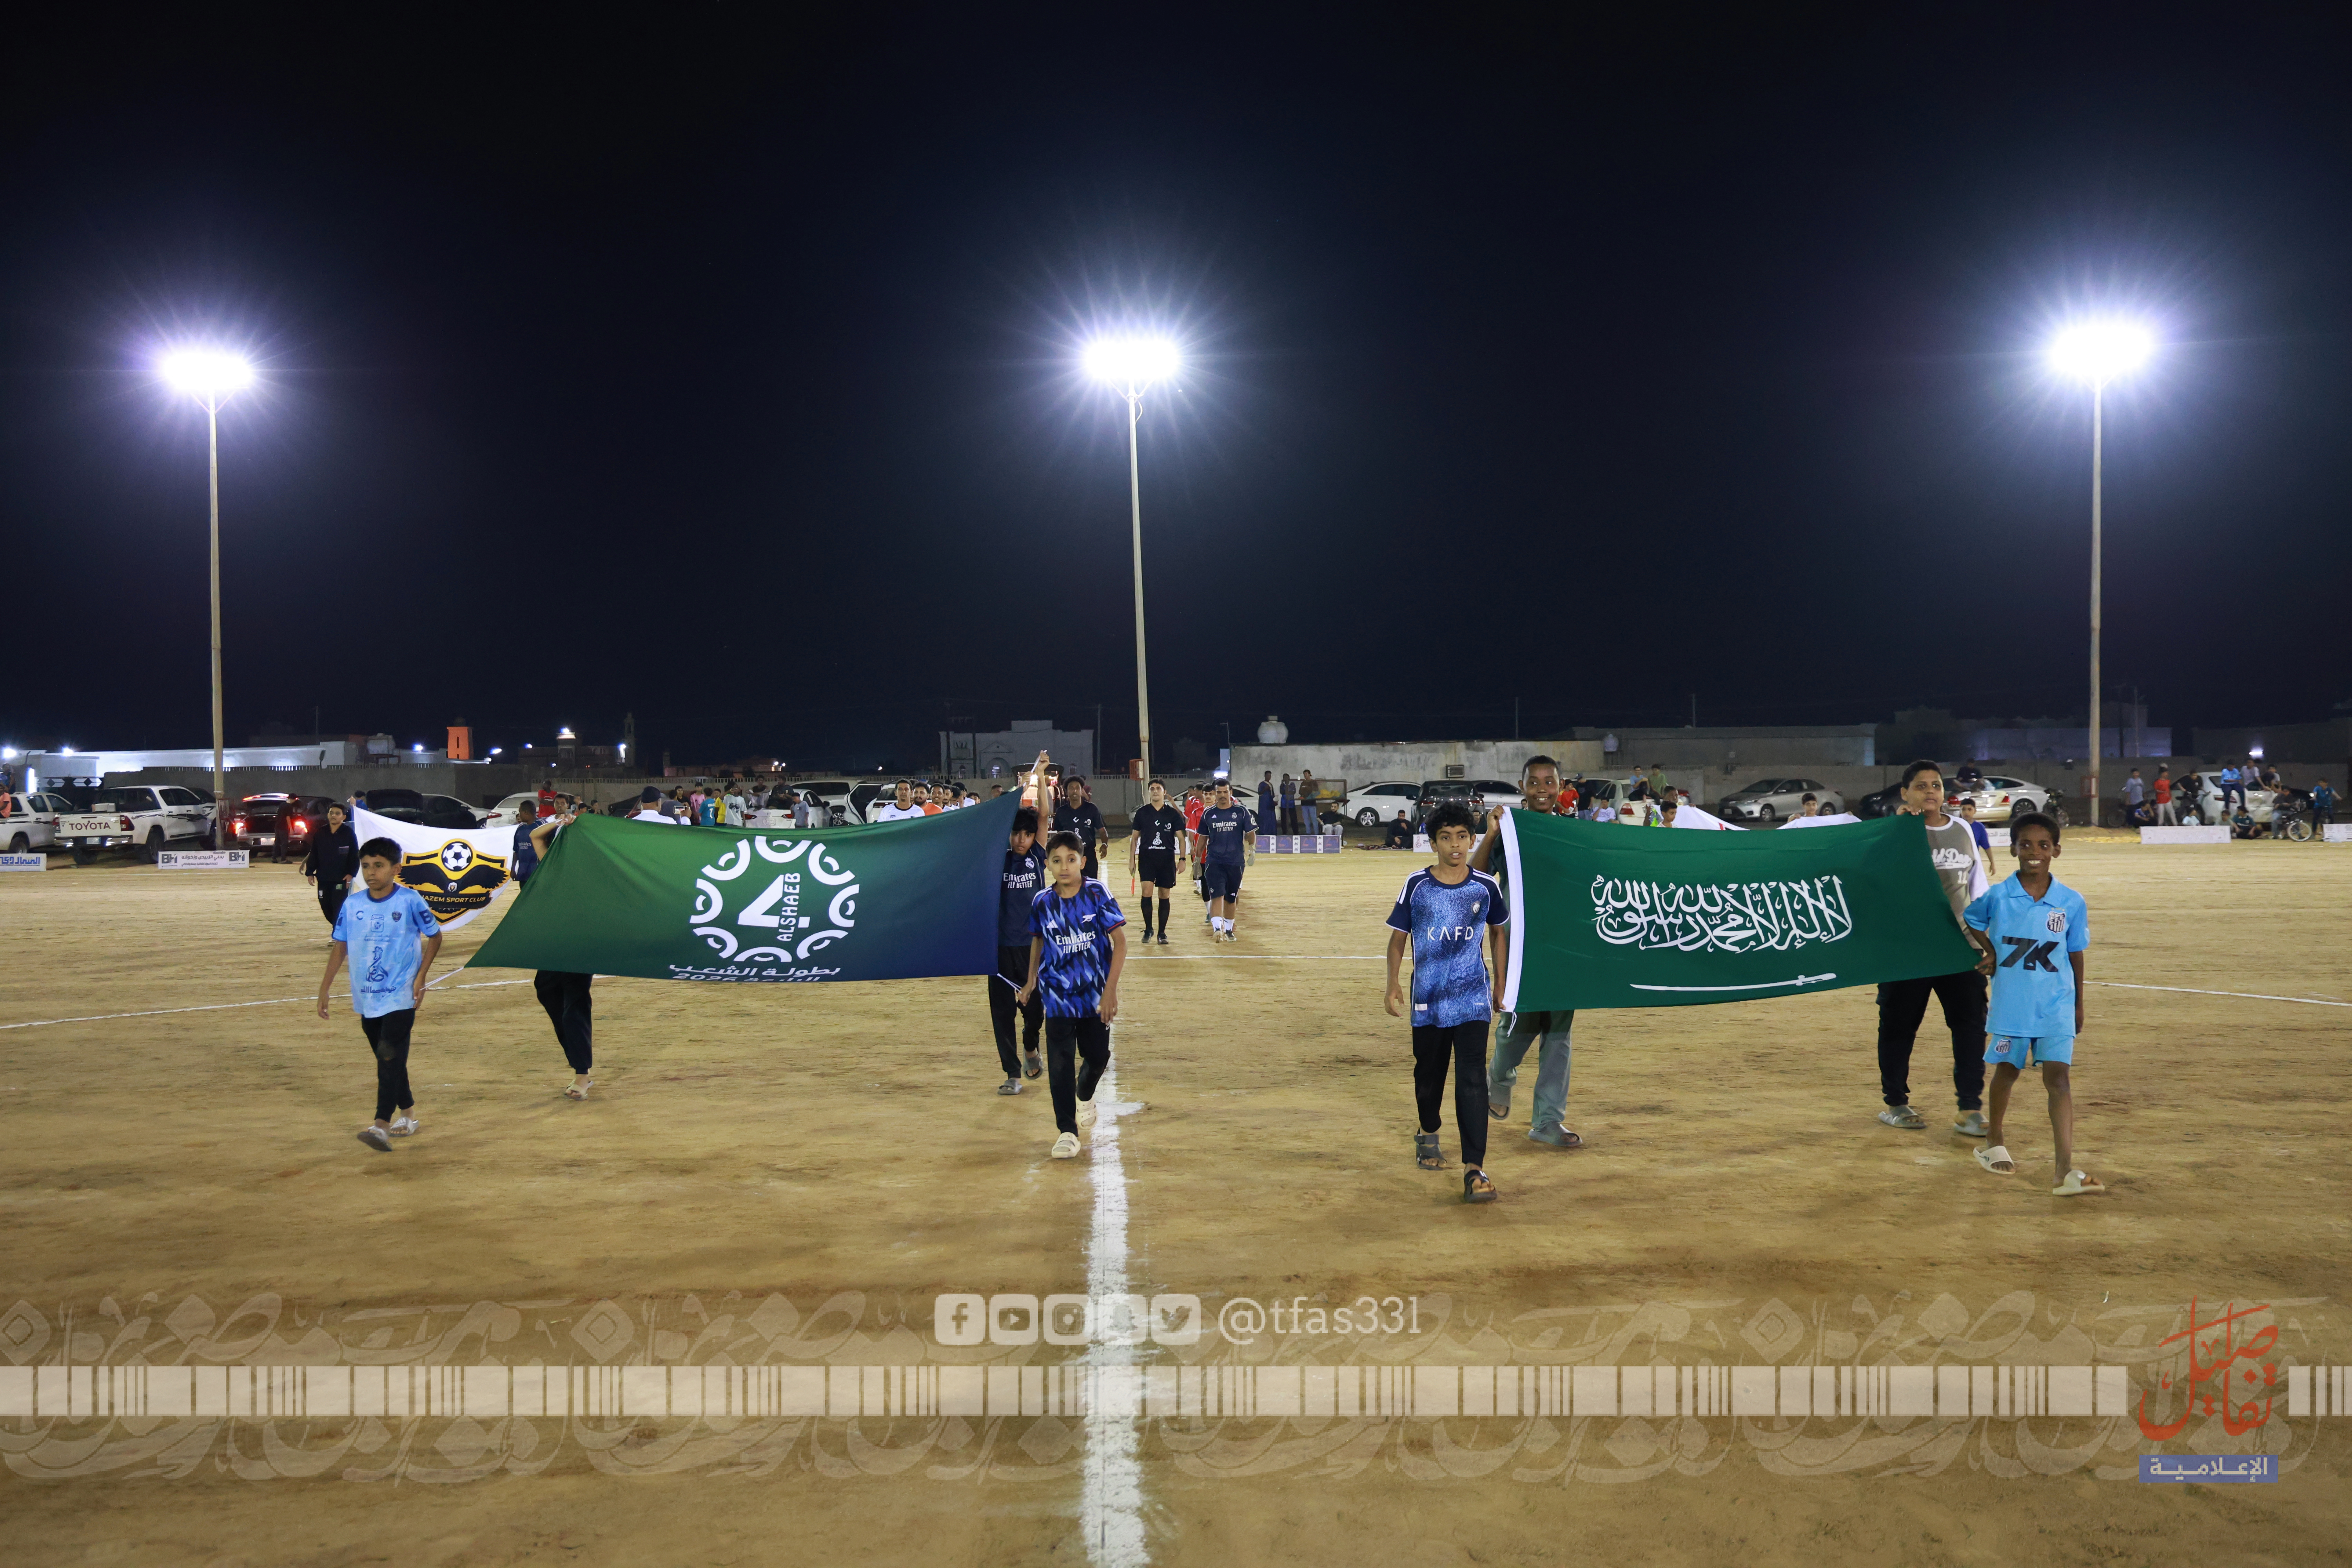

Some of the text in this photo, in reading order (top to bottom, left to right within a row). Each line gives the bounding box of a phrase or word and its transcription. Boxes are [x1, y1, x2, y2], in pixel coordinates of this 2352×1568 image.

[69, 822, 111, 831] TOYOTA
[1016, 880, 1033, 889] BETTER
[776, 873, 800, 942] ALSHAEB
[1055, 931, 1096, 945] Emirates
[1427, 926, 1474, 941] KAFD
[1063, 941, 1091, 954] FLY BETTER
[1998, 936, 2060, 973] 7K
[670, 964, 841, 978] بطولة الشعب
